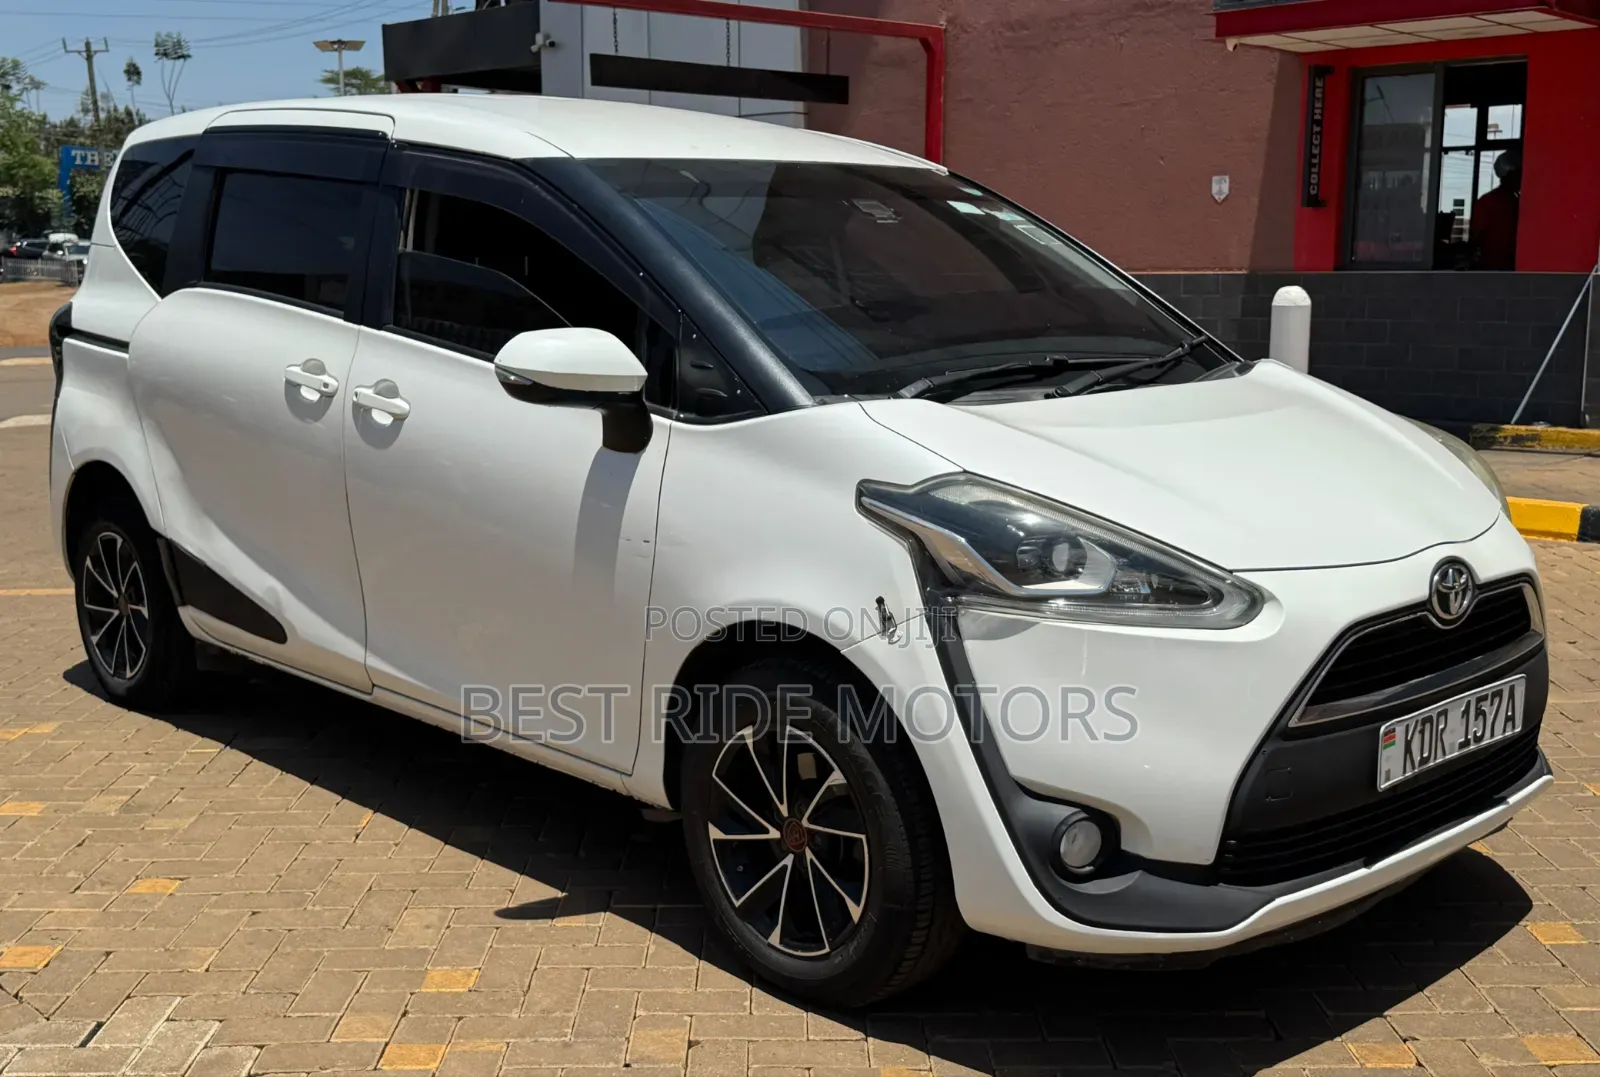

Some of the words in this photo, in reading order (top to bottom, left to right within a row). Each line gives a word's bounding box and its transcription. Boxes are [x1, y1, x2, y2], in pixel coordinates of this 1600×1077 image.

[1314, 78, 1324, 120] HERE
[1309, 124, 1320, 195] COLLECT
[1403, 708, 1449, 774] KDR
[1458, 683, 1516, 750] 157A
